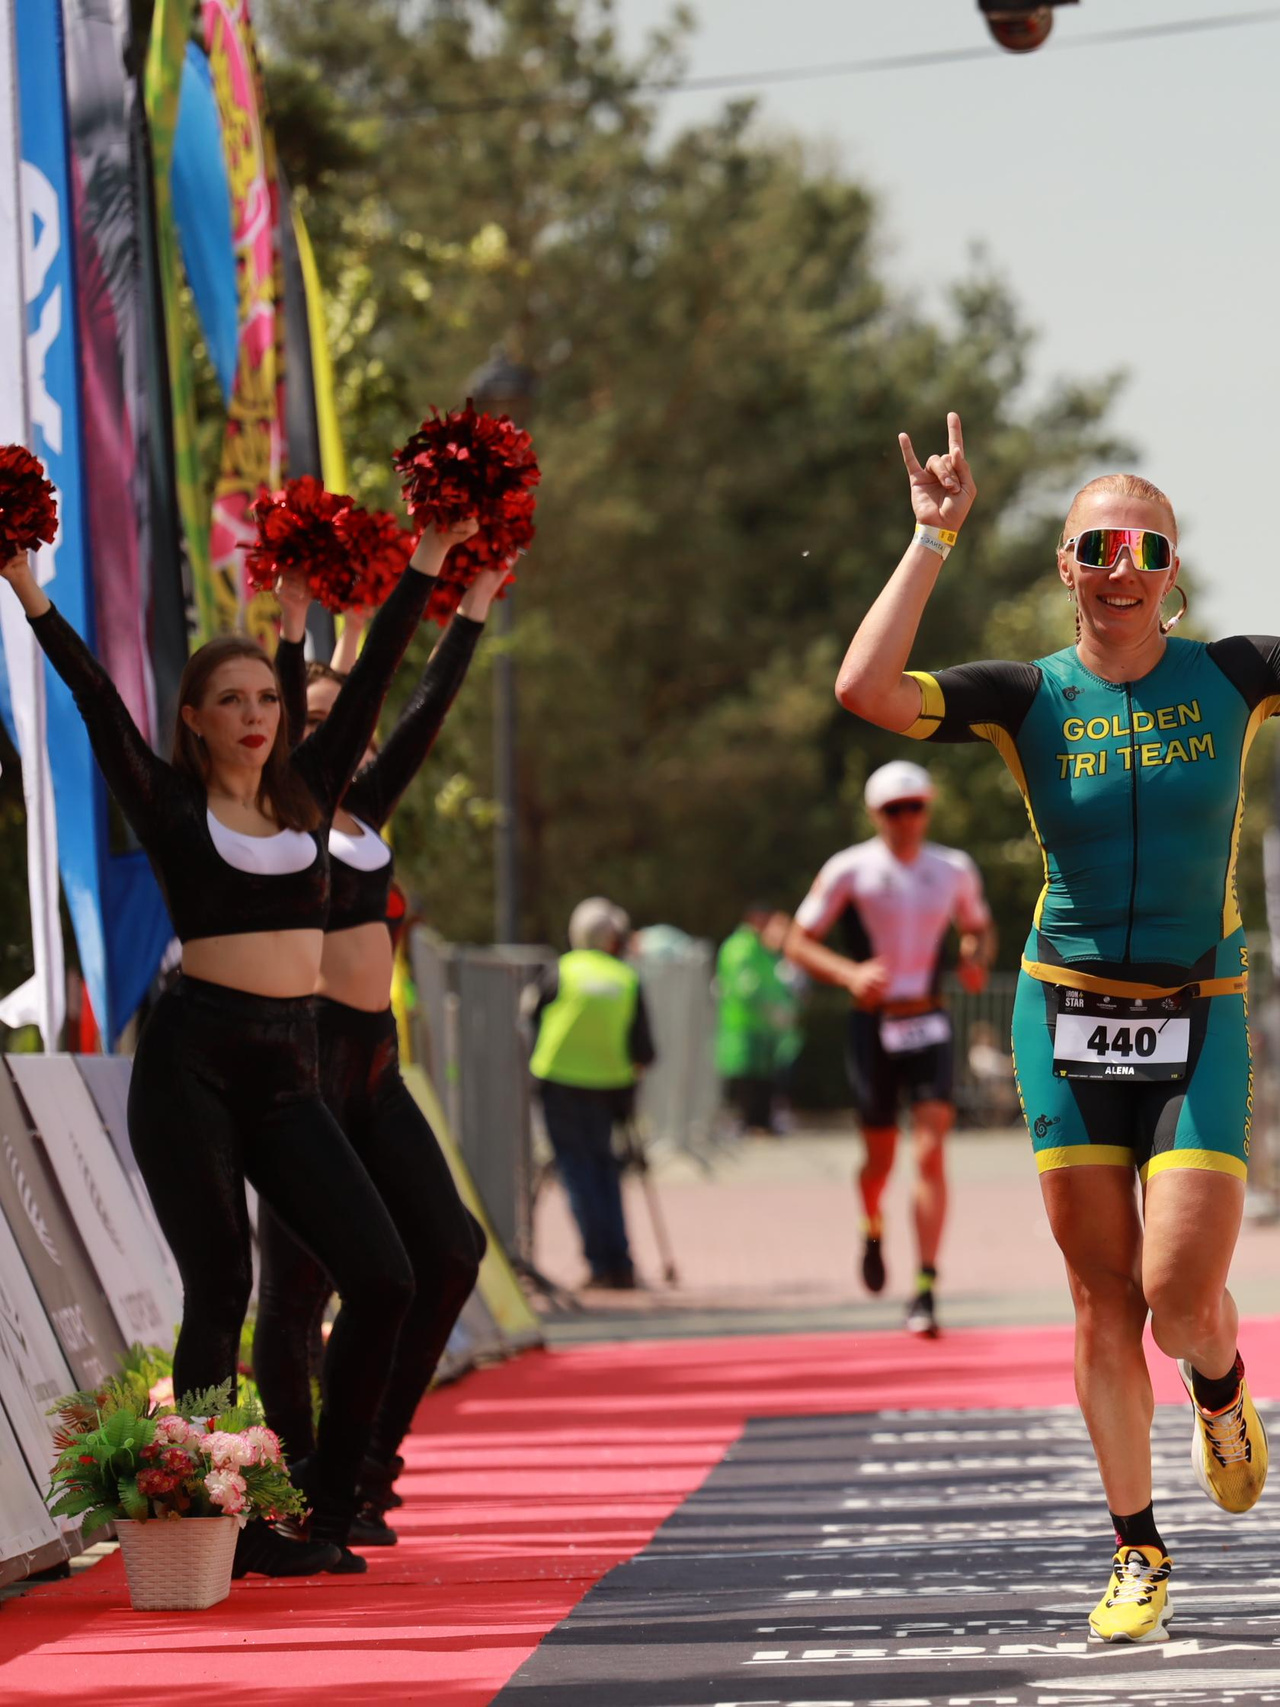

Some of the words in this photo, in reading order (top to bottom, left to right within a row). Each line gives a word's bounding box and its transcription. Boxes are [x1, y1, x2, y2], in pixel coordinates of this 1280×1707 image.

[1062, 698, 1202, 743] GOLDEN
[1054, 750, 1109, 781] TRI
[1116, 731, 1216, 772] TEAM
[1065, 997, 1084, 1008] STAR
[1087, 1025, 1157, 1058] 440
[1104, 1065, 1135, 1076] ALENA
[751, 1643, 1088, 1660] IRON
